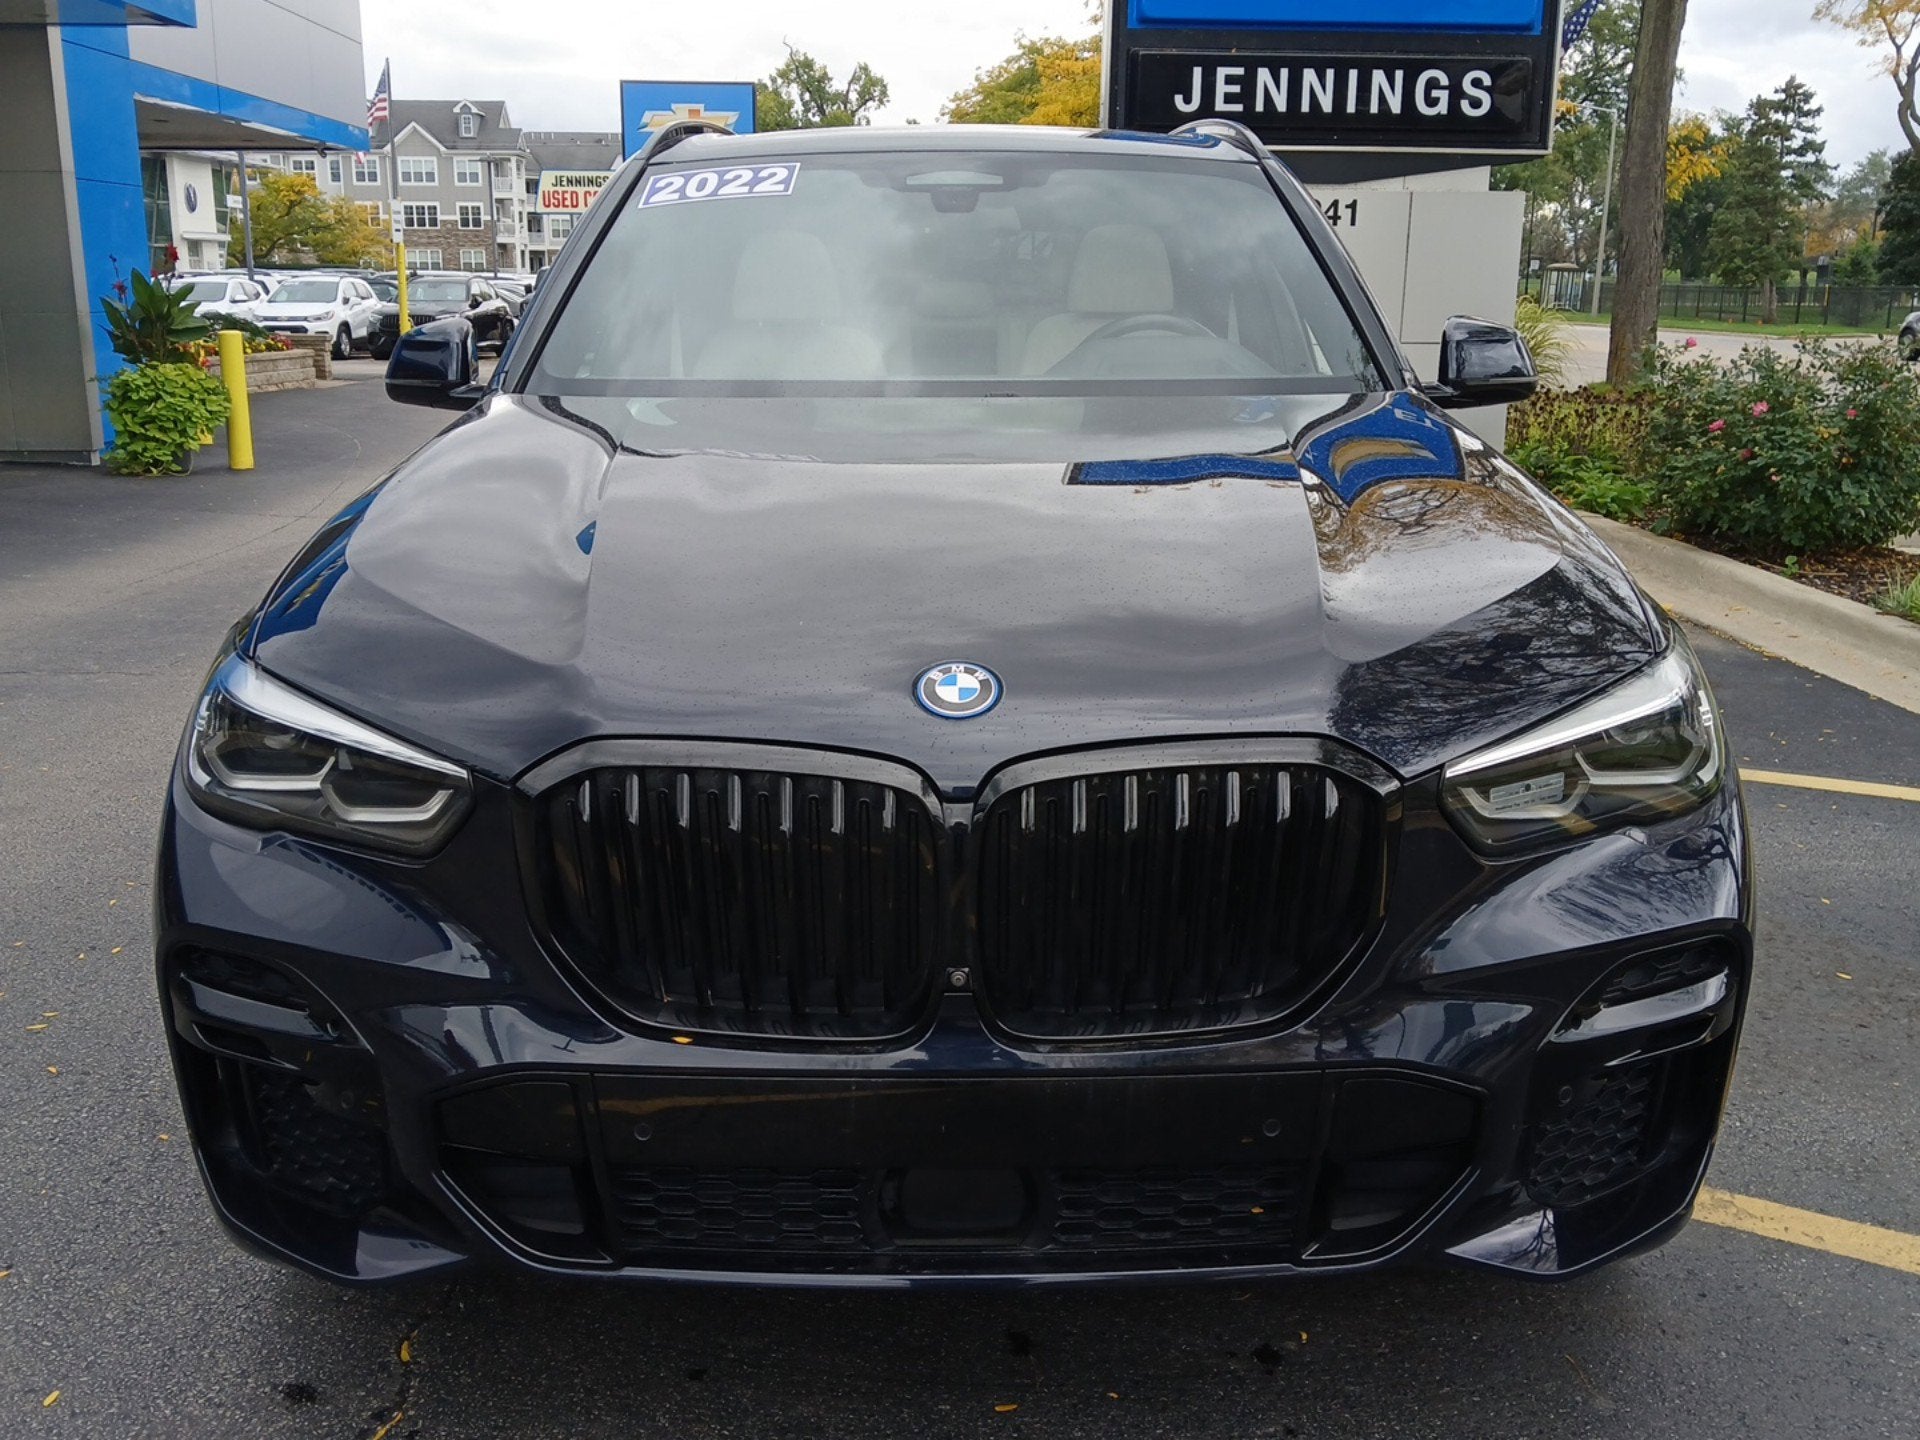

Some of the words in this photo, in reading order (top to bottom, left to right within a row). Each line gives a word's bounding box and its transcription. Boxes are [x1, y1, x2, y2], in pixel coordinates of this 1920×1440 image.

[1174, 66, 1493, 117] JENNINGS
[542, 190, 580, 208] USED
[648, 167, 789, 203] 2022
[1313, 198, 1358, 226] 41
[928, 664, 989, 681] BMW
